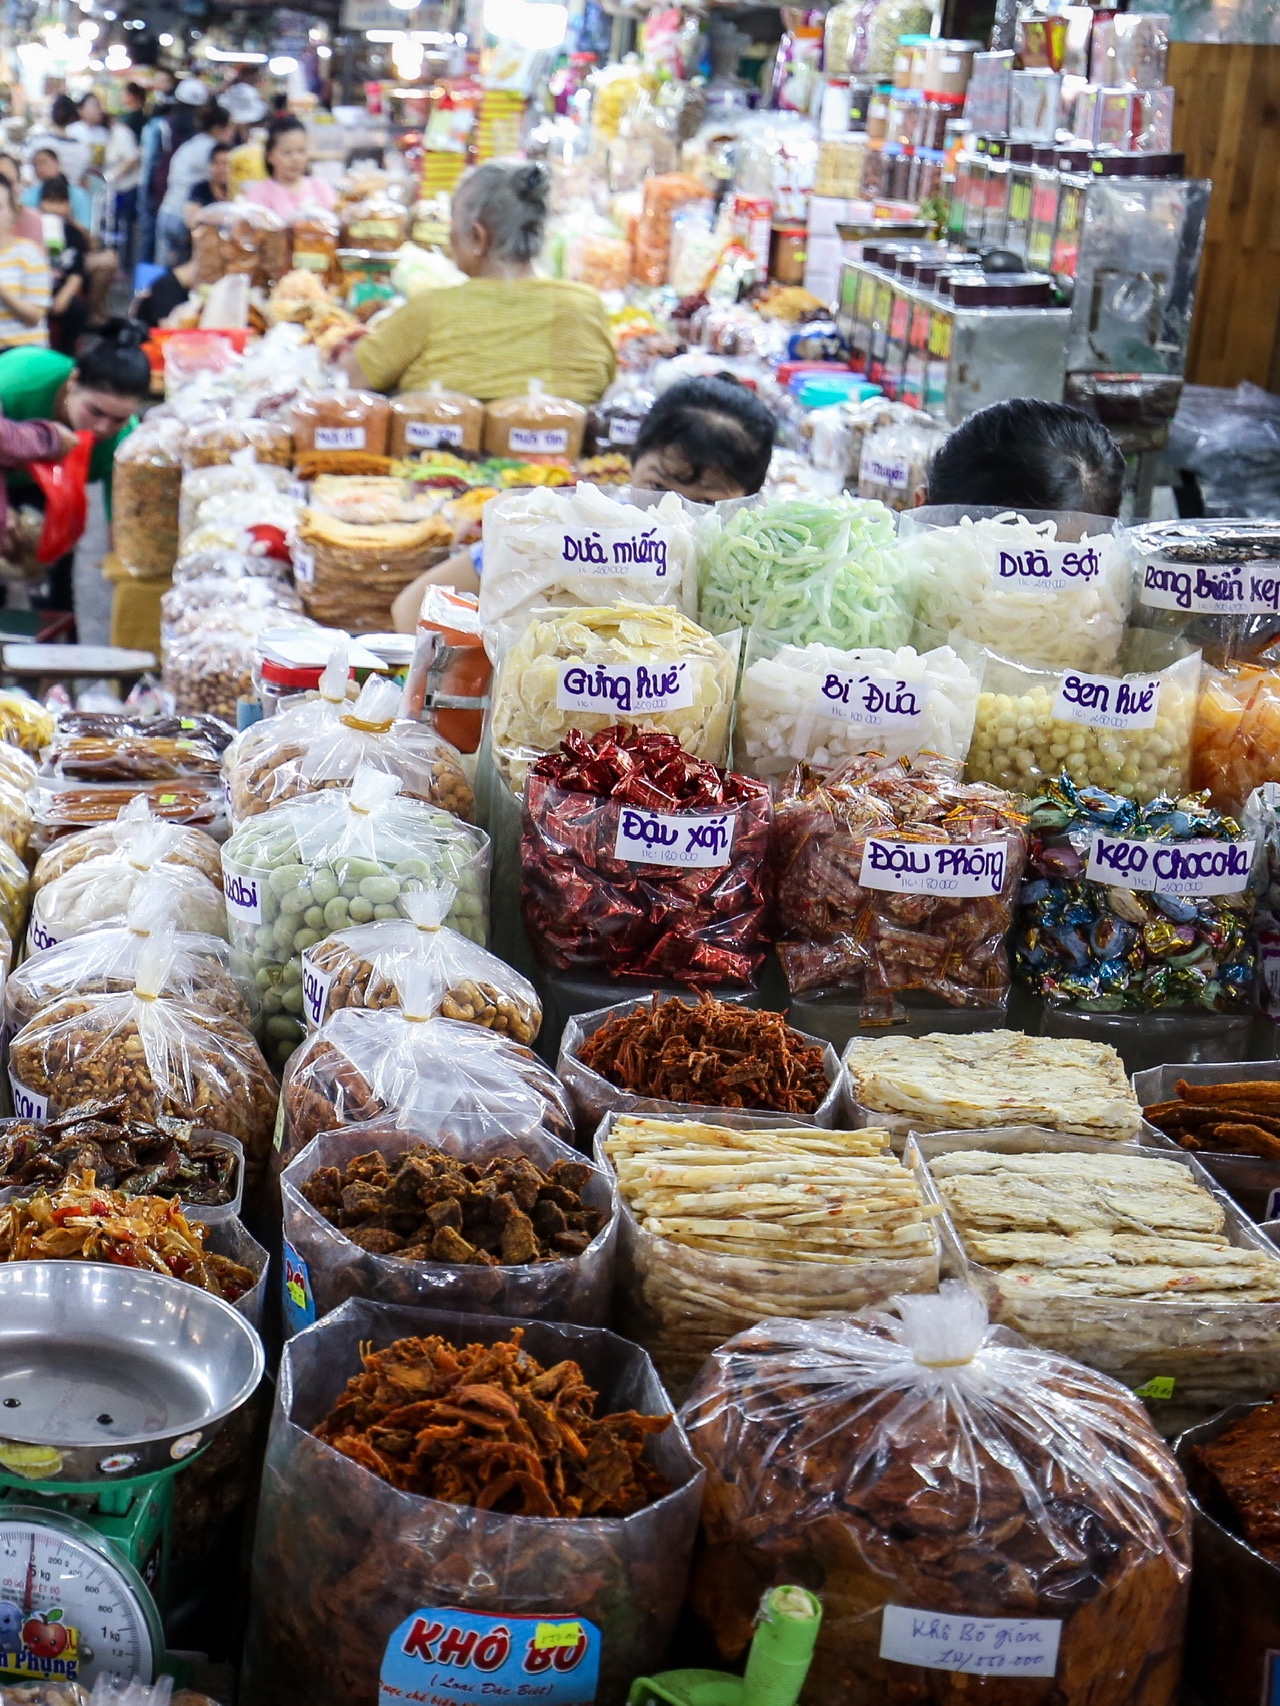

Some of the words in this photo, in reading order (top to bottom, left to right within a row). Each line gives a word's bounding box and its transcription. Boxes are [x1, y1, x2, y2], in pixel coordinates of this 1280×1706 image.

[622, 811, 679, 849] Đậu
[868, 841, 930, 879] Đậu
[84, 1585, 99, 1594] 600
[98, 1604, 112, 1614] 800
[402, 1618, 511, 1672] KHÔ
